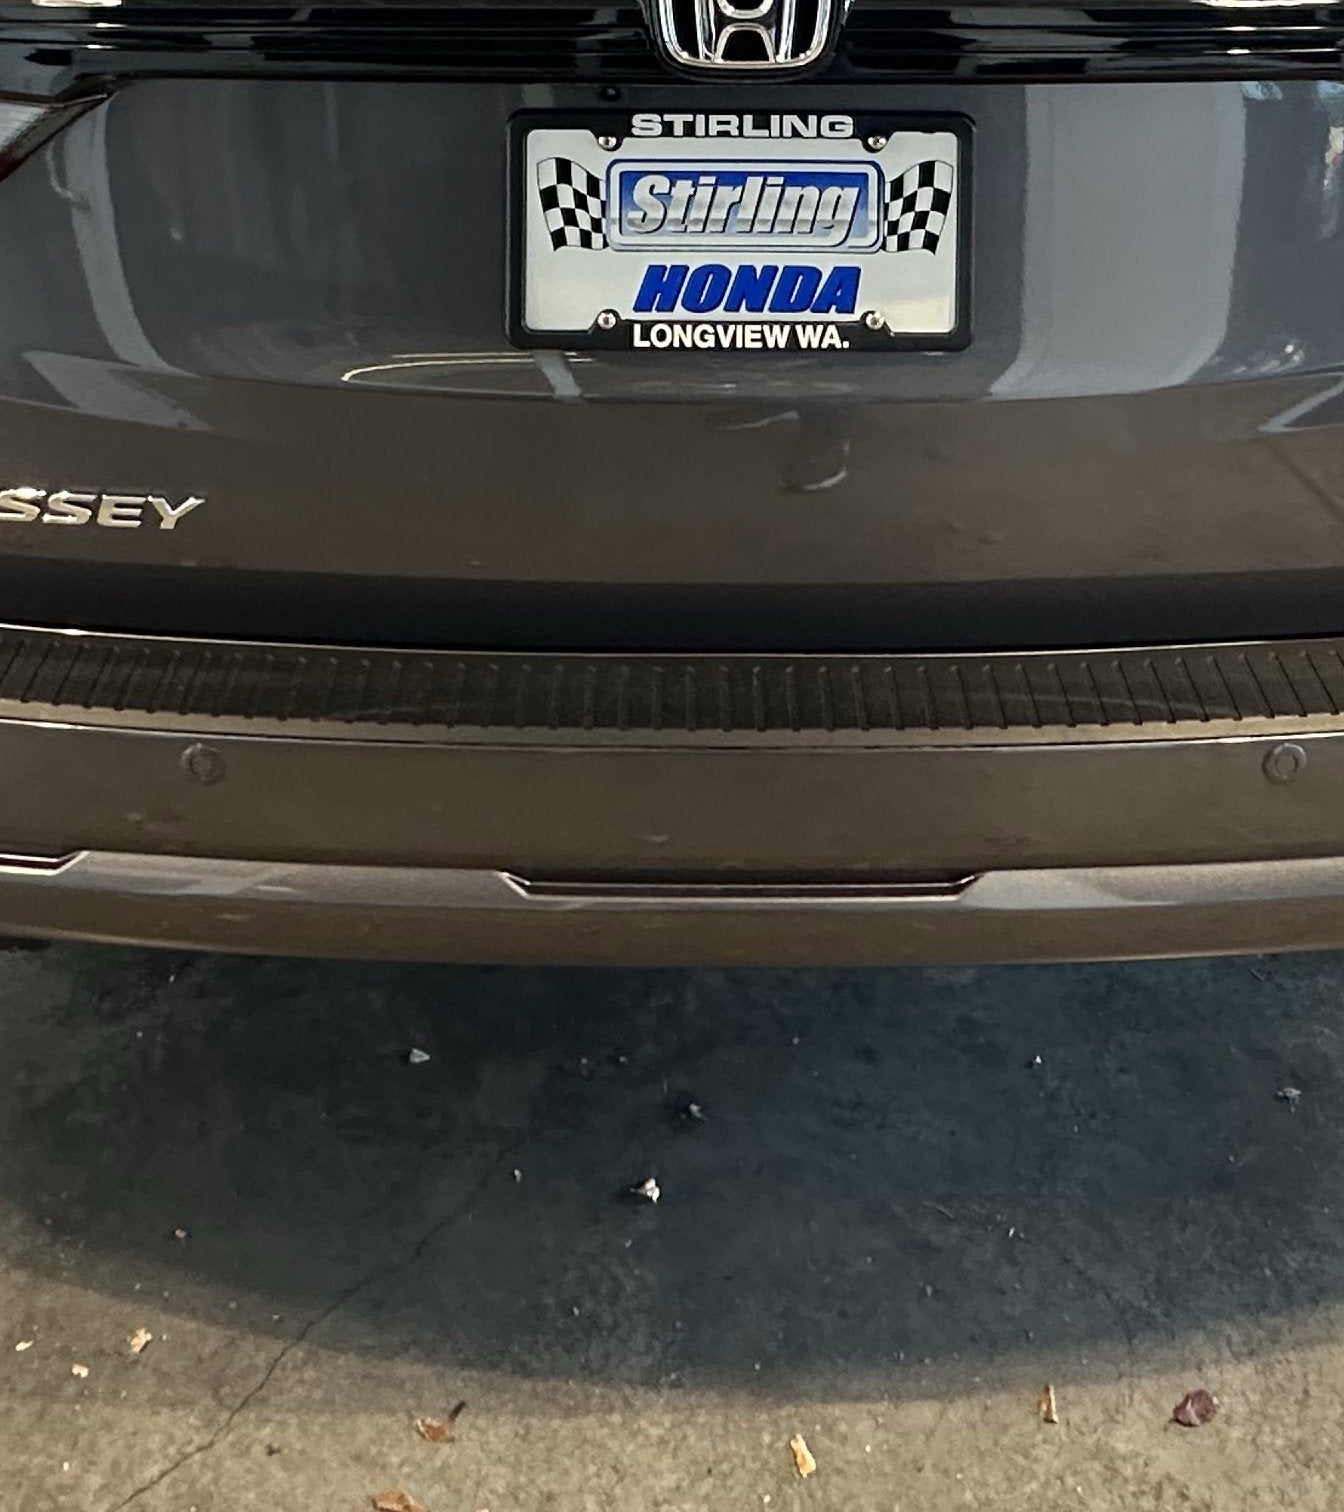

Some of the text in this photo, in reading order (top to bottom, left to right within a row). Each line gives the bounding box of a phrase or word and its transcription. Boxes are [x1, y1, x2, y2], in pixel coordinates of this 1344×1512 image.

[631, 113, 854, 138] STIRLING
[627, 175, 860, 247] Stirling
[632, 263, 862, 314] HONDA
[632, 323, 850, 349] LONGVIEW WA.
